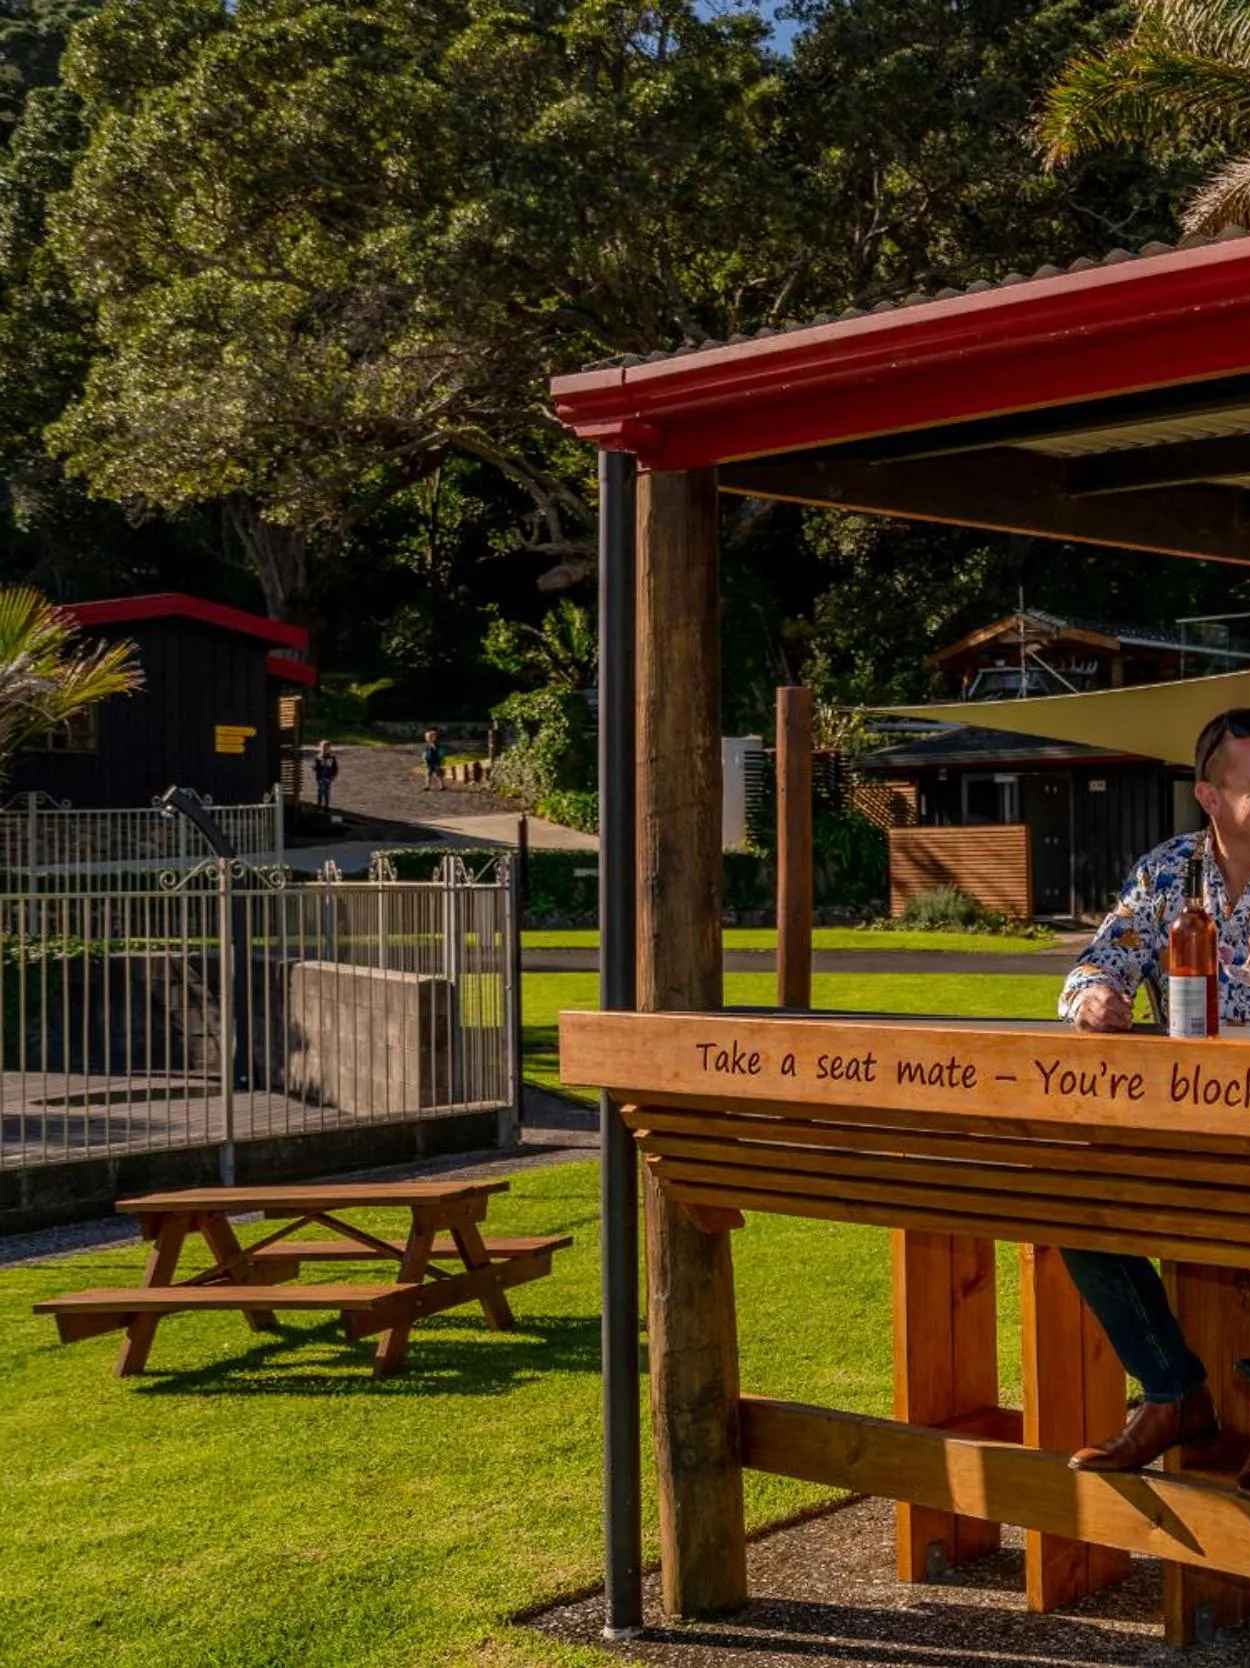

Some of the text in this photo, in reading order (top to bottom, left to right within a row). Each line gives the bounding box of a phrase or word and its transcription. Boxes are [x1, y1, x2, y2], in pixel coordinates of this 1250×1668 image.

[695, 1039, 762, 1076] Take
[780, 1053, 796, 1077] a
[816, 1052, 878, 1083] seat
[897, 1056, 978, 1089] mate
[1034, 1059, 1145, 1101] You're
